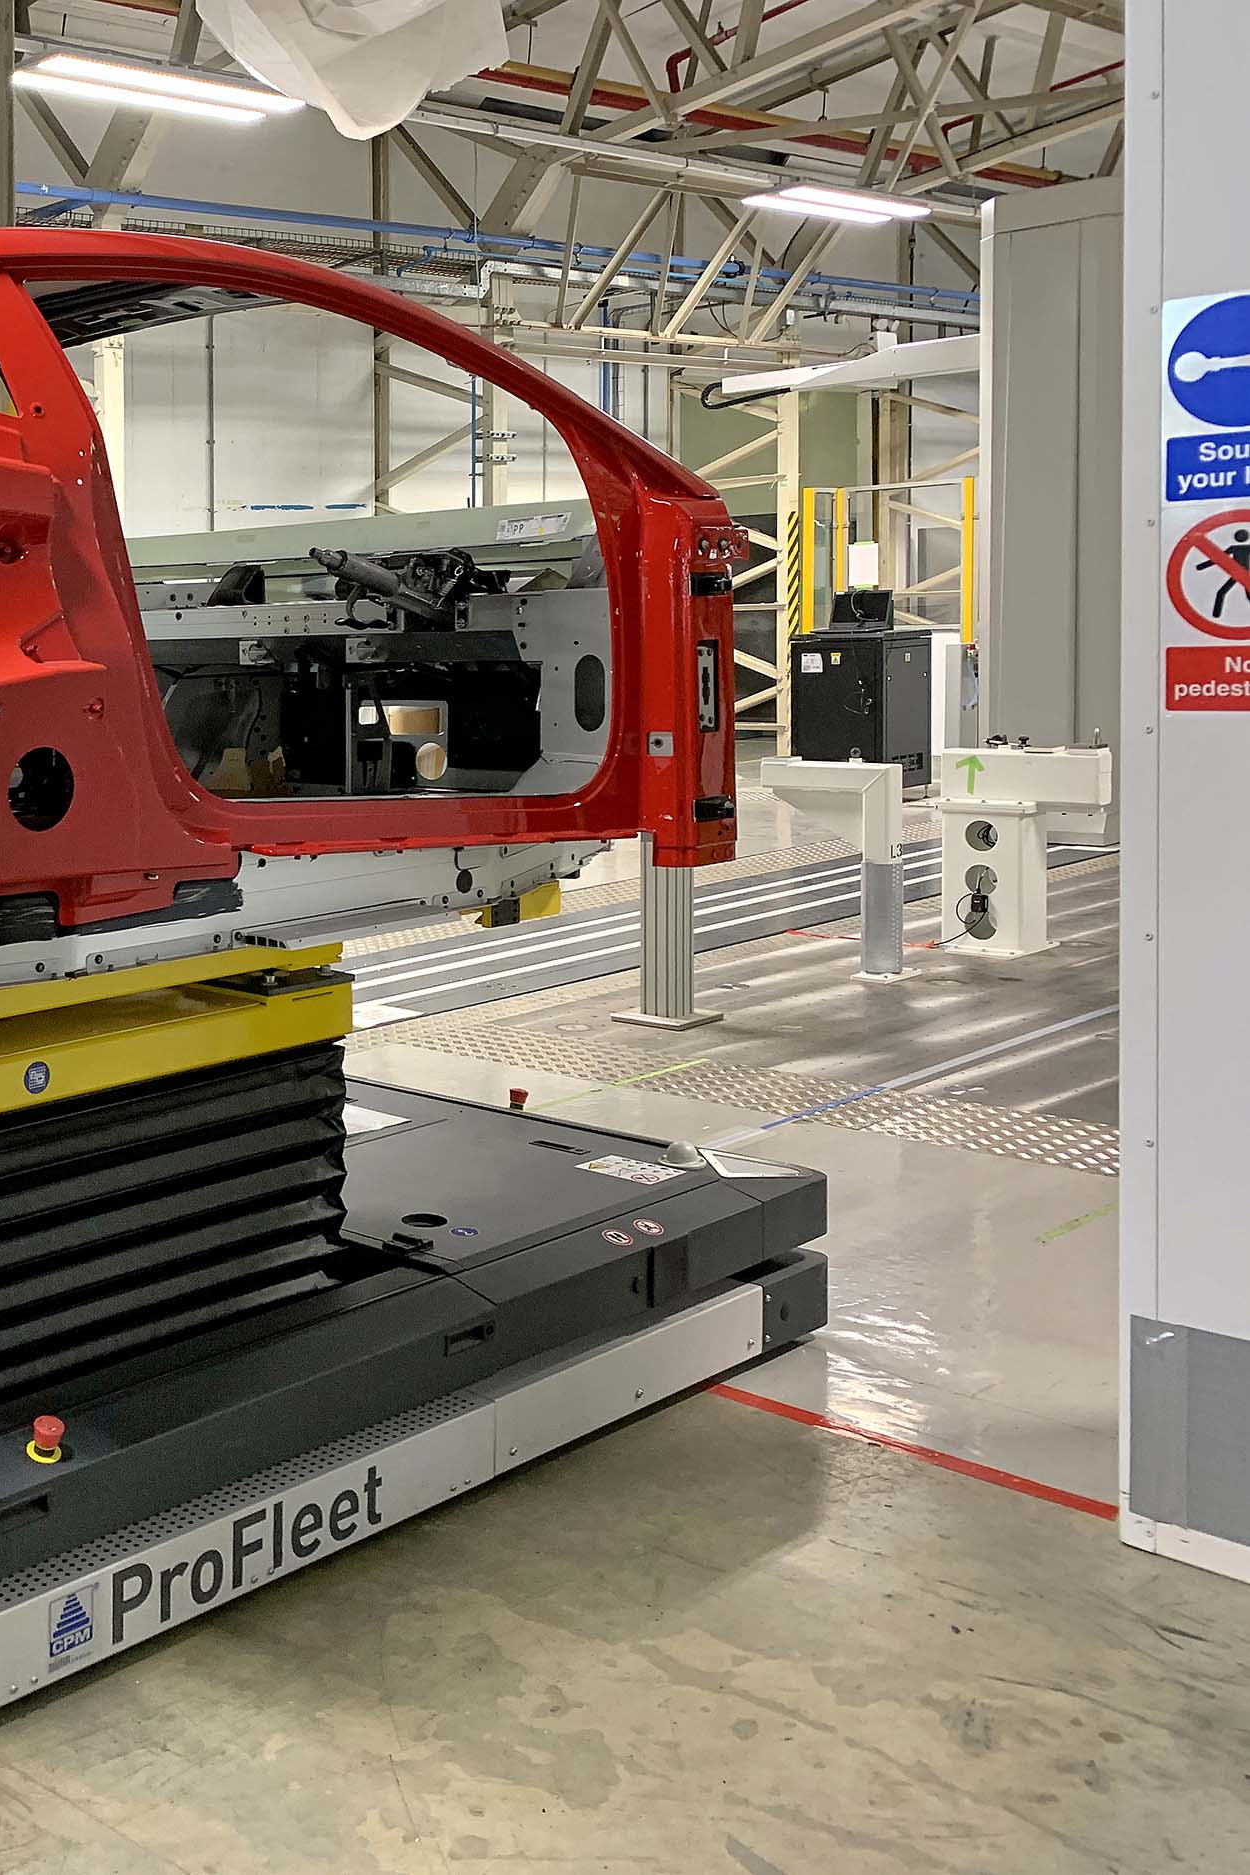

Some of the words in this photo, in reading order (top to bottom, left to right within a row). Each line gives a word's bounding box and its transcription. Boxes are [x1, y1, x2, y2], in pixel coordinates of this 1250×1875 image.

[1199, 441, 1250, 462] Sou
[1177, 470, 1237, 495] your
[890, 843, 903, 859] L3
[111, 1465, 383, 1645] ProFleet
[52, 1627, 91, 1655] CPM
